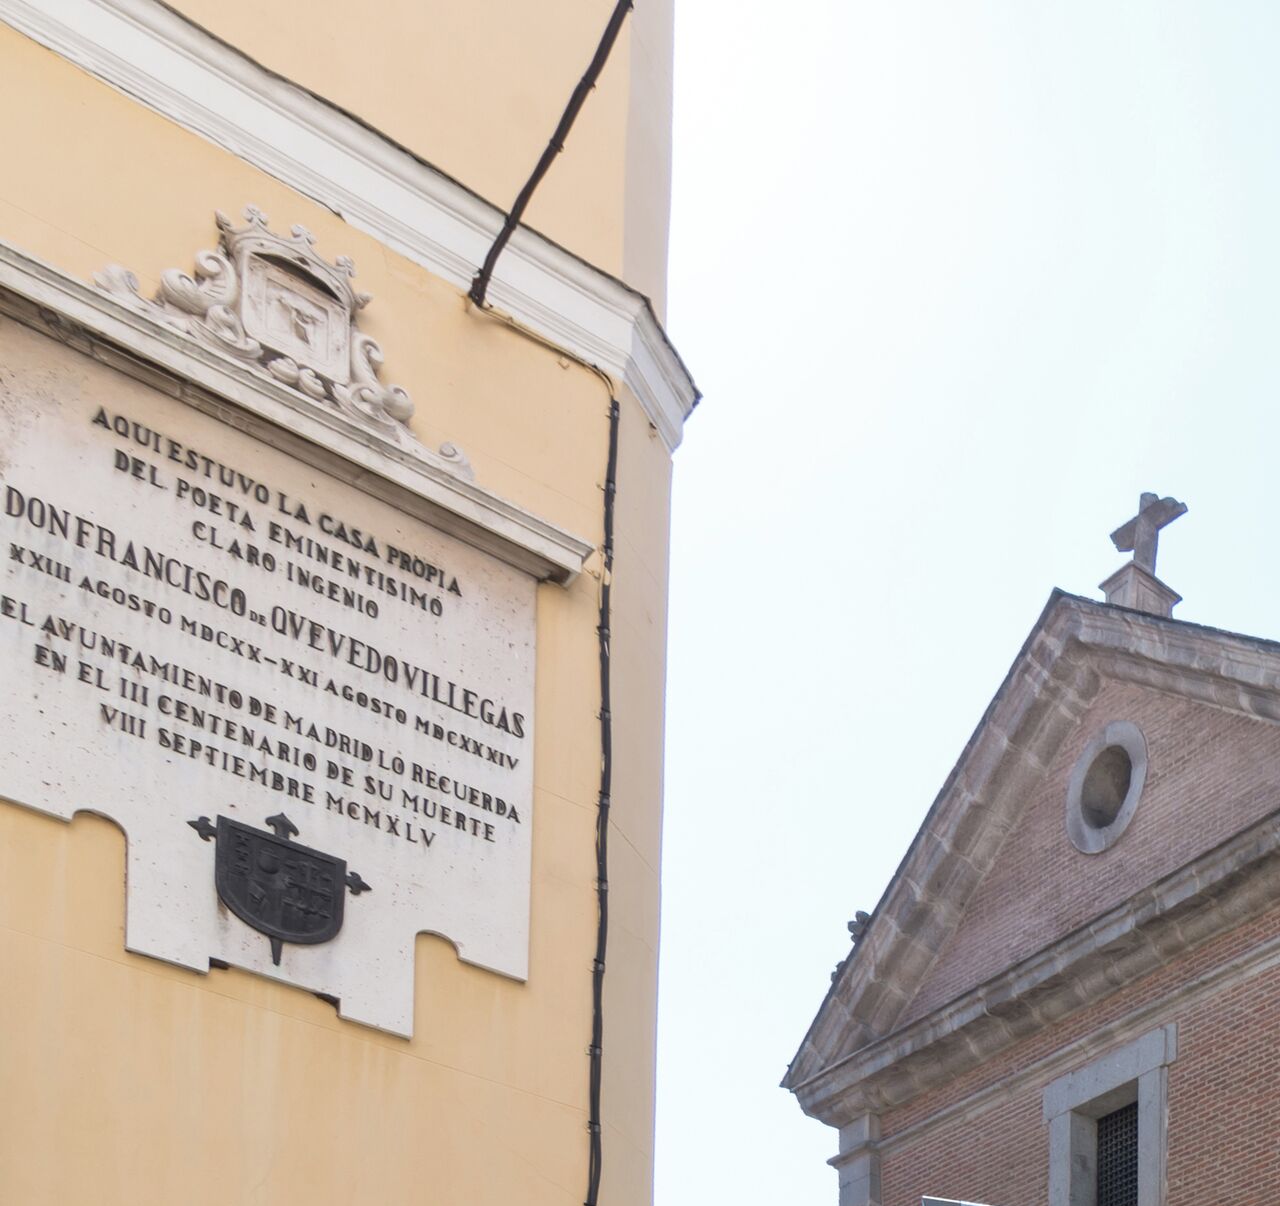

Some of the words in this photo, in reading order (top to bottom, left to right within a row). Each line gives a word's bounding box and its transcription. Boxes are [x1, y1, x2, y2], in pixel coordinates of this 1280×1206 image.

[114, 449, 165, 490] DEL
[175, 477, 256, 532] POETA
[268, 521, 444, 618] EMINENTISIMO
[192, 520, 277, 573] CLARO
[286, 561, 379, 619] INGENIO
[279, 492, 312, 526] LA
[318, 514, 381, 558] CASA
[386, 545, 463, 598] PROPIA
[1, 594, 35, 626] EL
[41, 614, 243, 710] AYUNTAMIENTO
[249, 696, 278, 725] DE
[284, 711, 374, 762] MADRID
[378, 749, 405, 776] LO
[412, 762, 521, 824] RECUERDA
[8, 542, 72, 584] XXIII
[78, 575, 173, 626] AGOSTO
[323, 678, 408, 725] AGOSTO
[415, 714, 520, 770] MDCXXXIV
[74, 515, 248, 618] FRANCISCO
[401, 660, 525, 739] VILLEGAS
[34, 643, 67, 674] EN
[77, 660, 111, 692] EL
[120, 677, 150, 708] III
[157, 694, 317, 772] CENTENARIO
[326, 760, 355, 787] DE
[364, 776, 394, 801] SU
[401, 789, 496, 843] MUERTE
[99, 702, 147, 740] VIII
[158, 727, 315, 804] SEPTIEMBRE
[326, 791, 436, 848] MCMXLV
